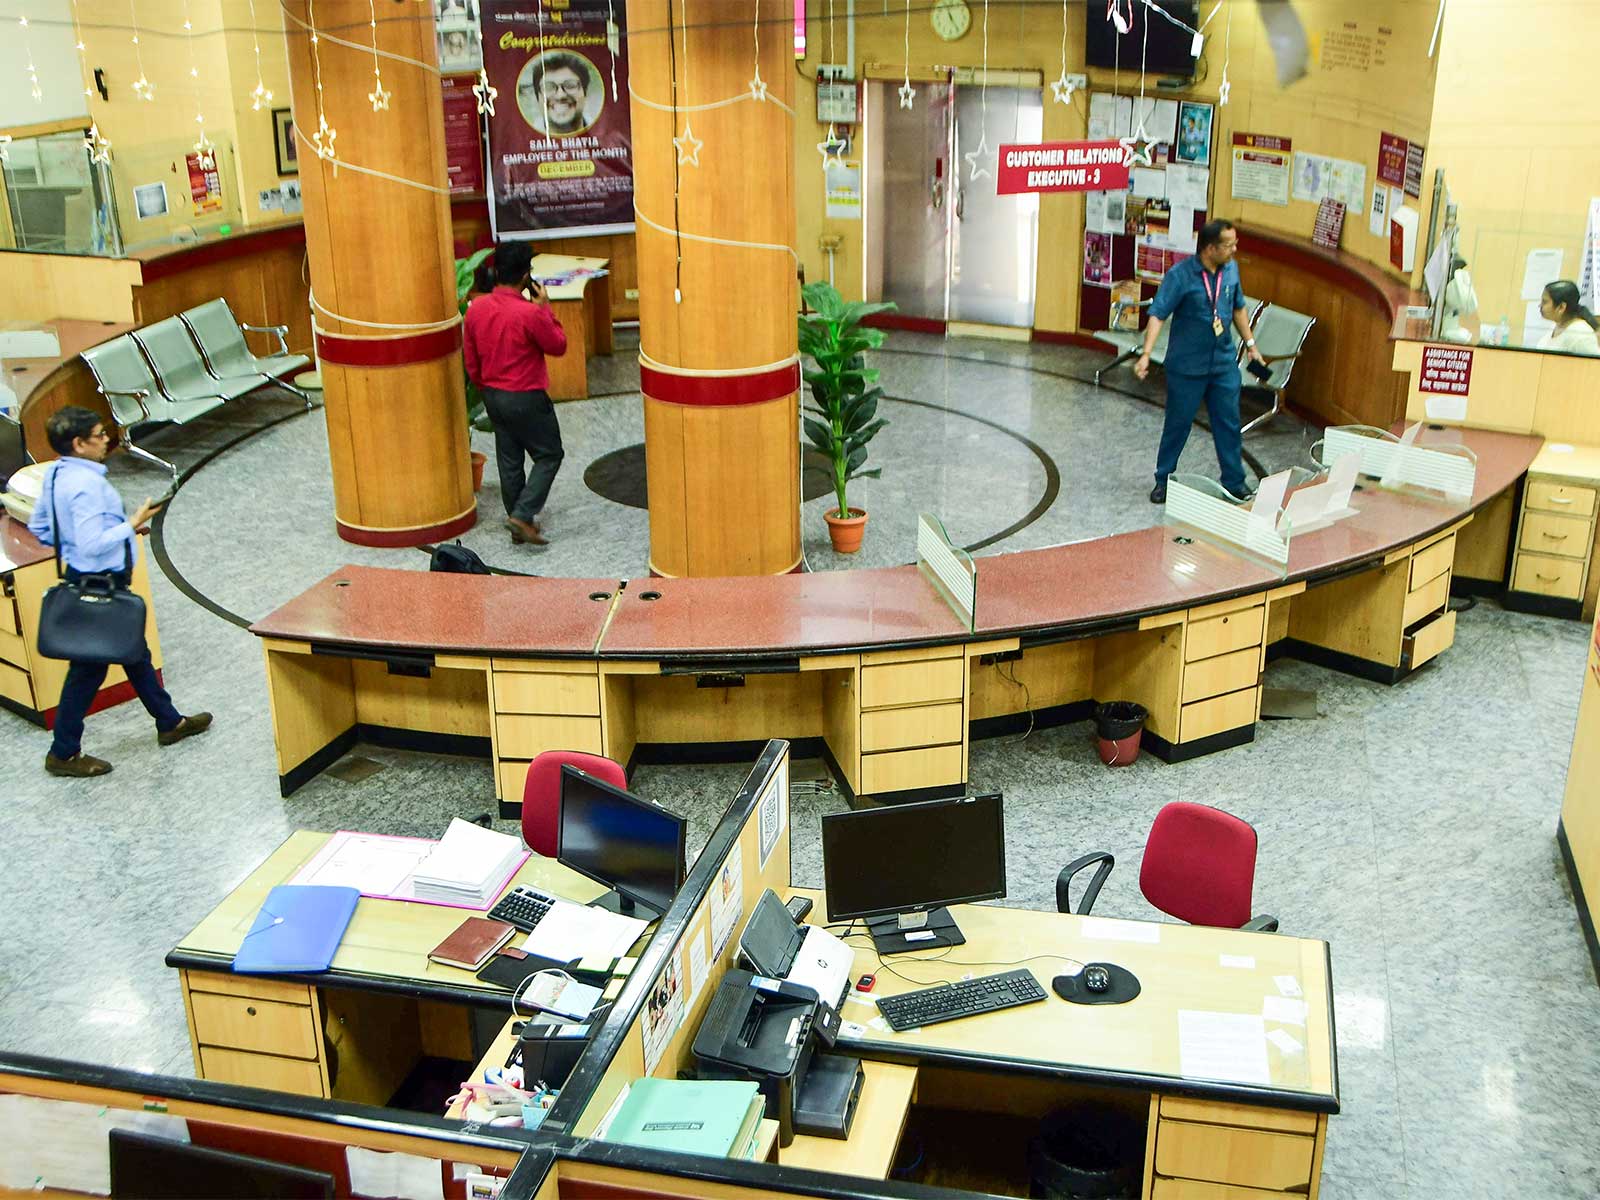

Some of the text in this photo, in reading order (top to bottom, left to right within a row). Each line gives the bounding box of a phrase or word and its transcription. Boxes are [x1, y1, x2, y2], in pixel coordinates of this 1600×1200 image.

[503, 147, 627, 166] EMPLOYEE OF THE MONTH
[1006, 147, 1124, 168] CUSTOMER RELATIONS
[540, 163, 592, 174] DECEMBER
[1027, 169, 1086, 188] EXECUTIVE
[1093, 169, 1101, 185] 3
[1425, 348, 1470, 360] ASSISTANCE FOR
[1426, 358, 1467, 371] SENIOR CITIZEN
